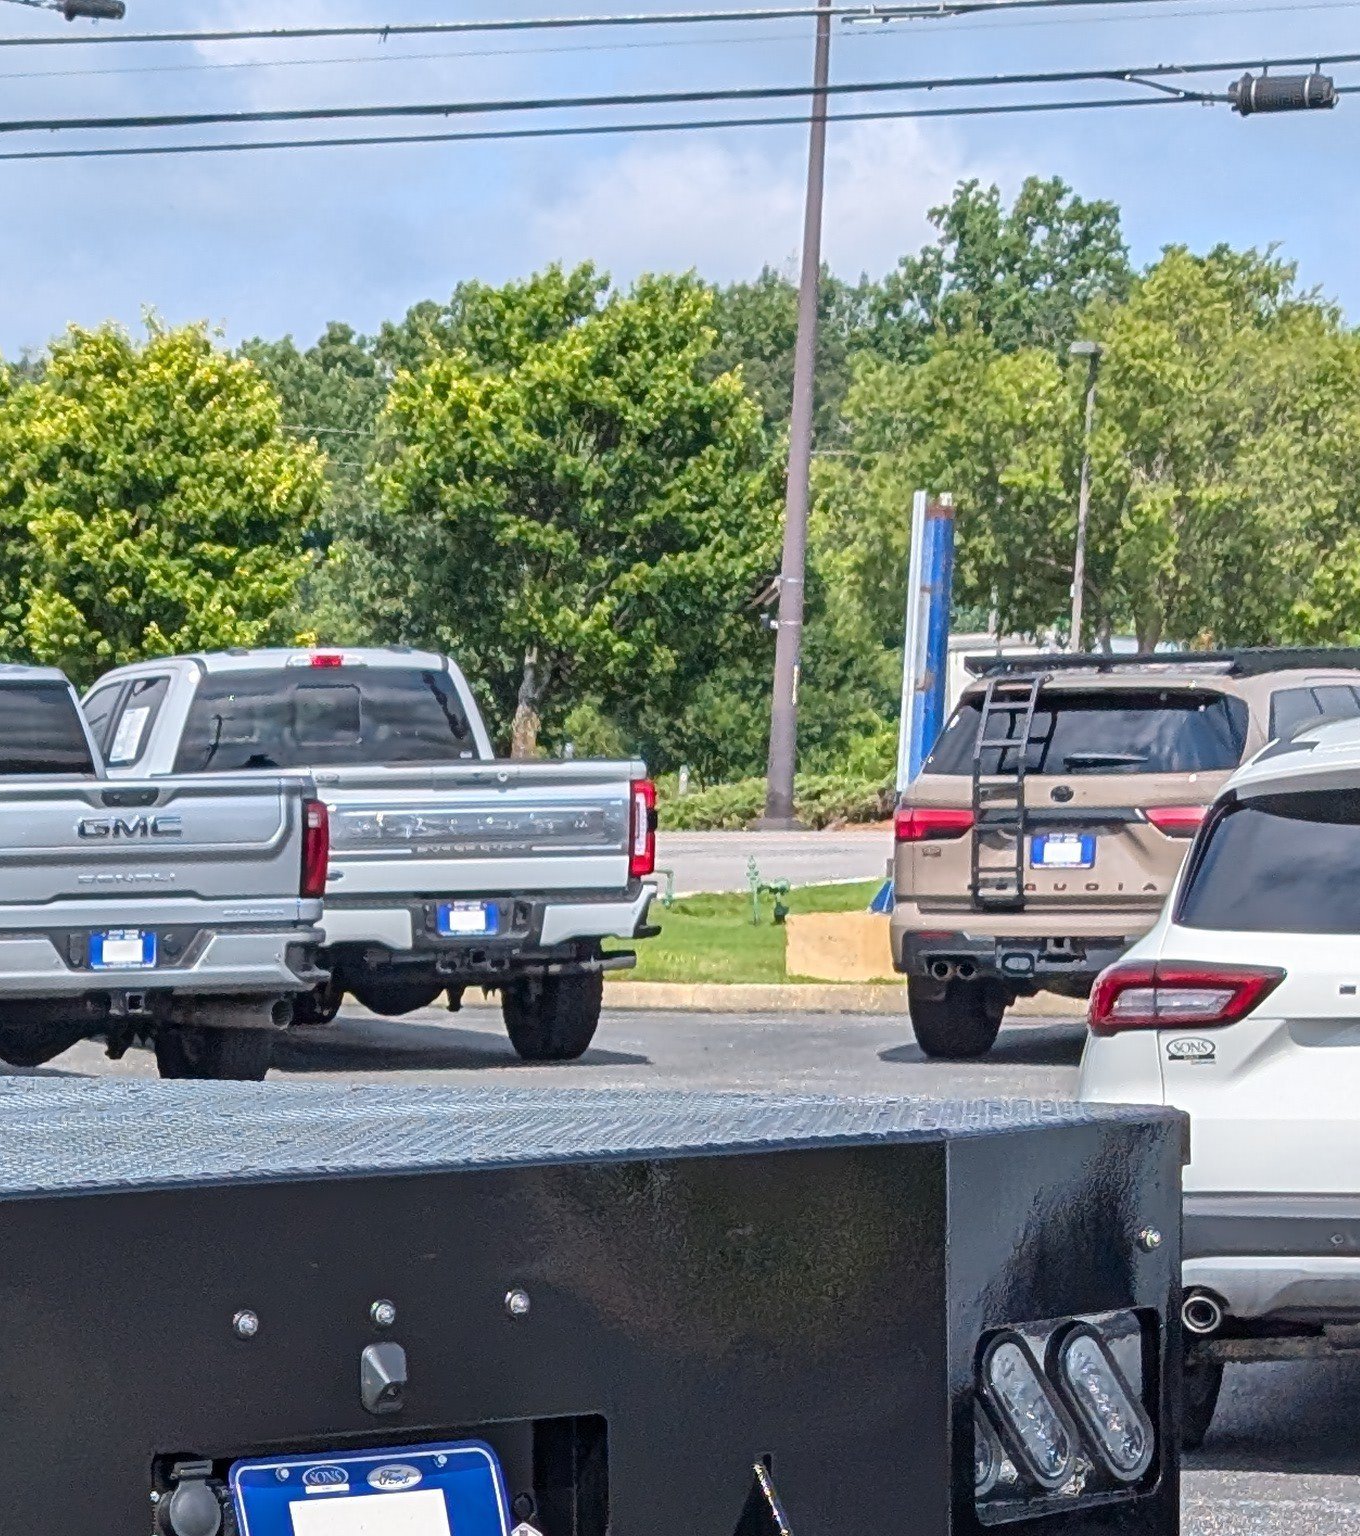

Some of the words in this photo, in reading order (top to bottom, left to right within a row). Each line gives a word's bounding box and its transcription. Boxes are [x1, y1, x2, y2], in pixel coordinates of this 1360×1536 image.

[77, 814, 183, 839] GMC
[1174, 1041, 1208, 1054] SONS
[308, 1469, 344, 1486] SONS
